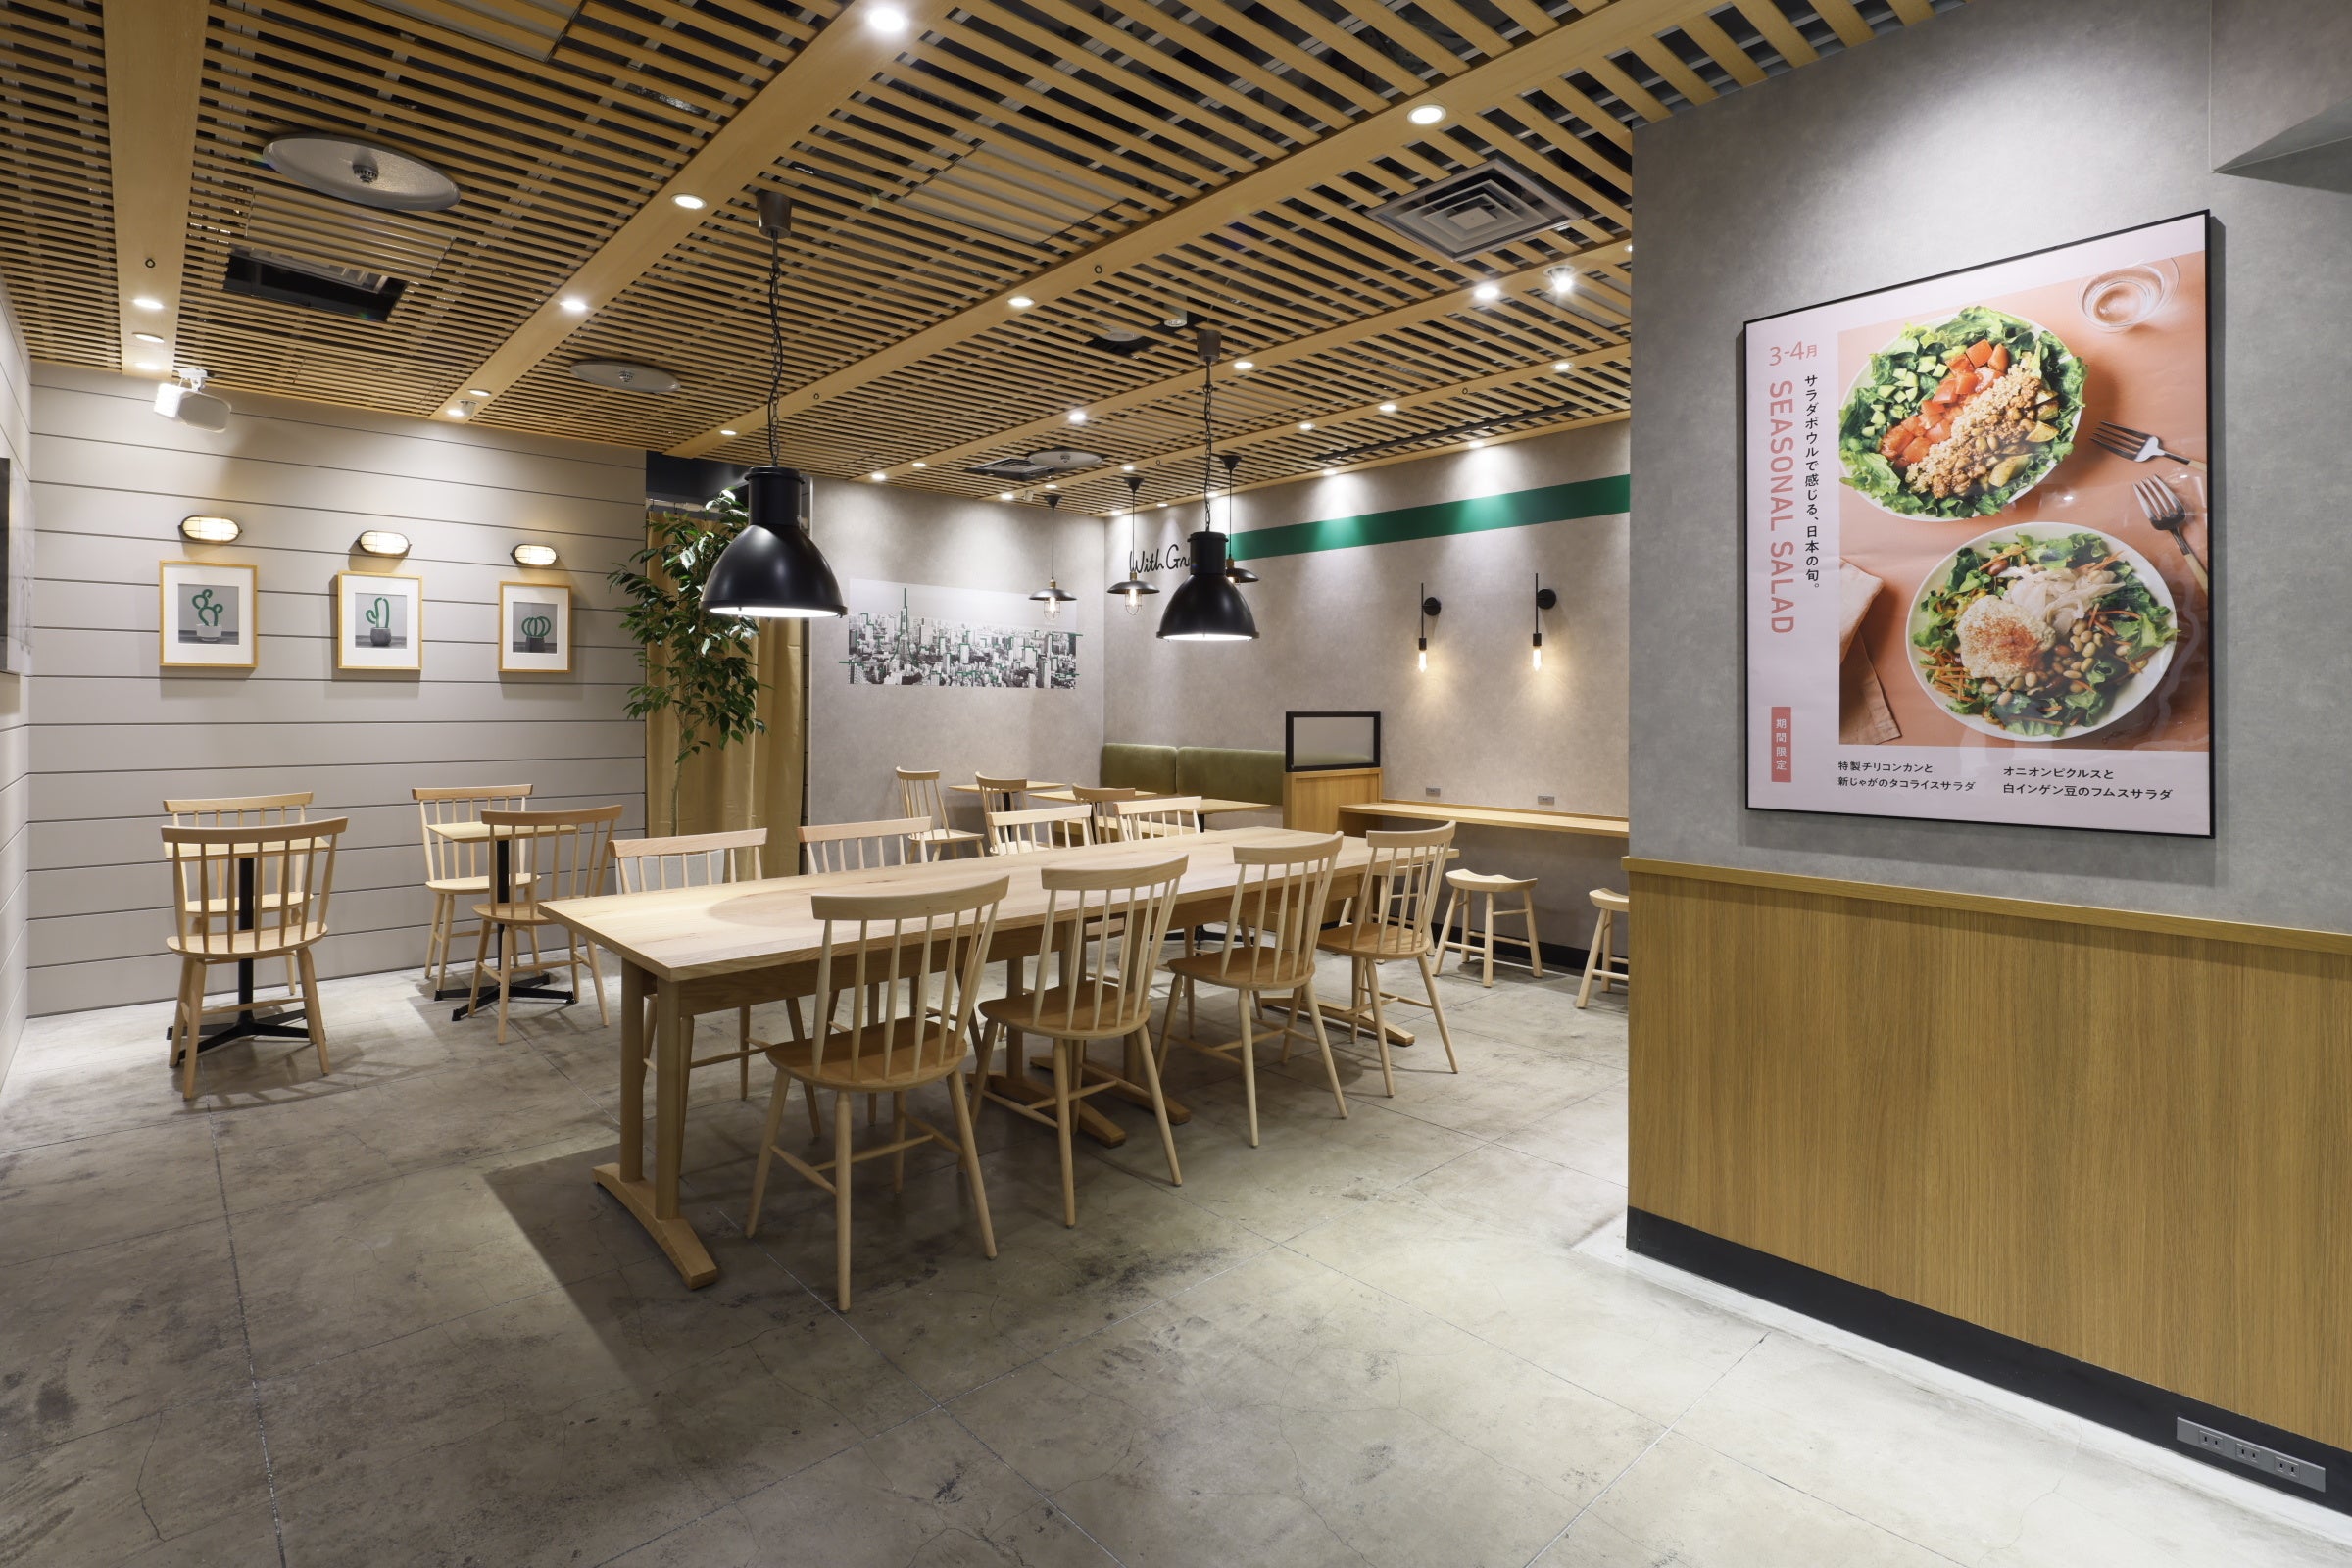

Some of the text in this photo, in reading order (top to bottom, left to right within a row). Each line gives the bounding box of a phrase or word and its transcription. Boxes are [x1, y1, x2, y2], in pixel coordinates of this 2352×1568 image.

[1769, 340, 1818, 367] 3-4月
[1804, 374, 1820, 588] サラダボウルで感じる、日本の旬。
[1769, 380, 1794, 634] SEASONAL SALAD
[1129, 544, 1190, 574] With Gr
[1775, 718, 1788, 771] 期間限定
[1838, 760, 1934, 774] 特製チリコンカンと
[2003, 766, 2115, 780] オニオンピクルスと
[1838, 776, 1977, 792] 新じゃがのタコライスサラダ
[2003, 783, 2173, 800] 白インゲン豆のフムスサラダ
